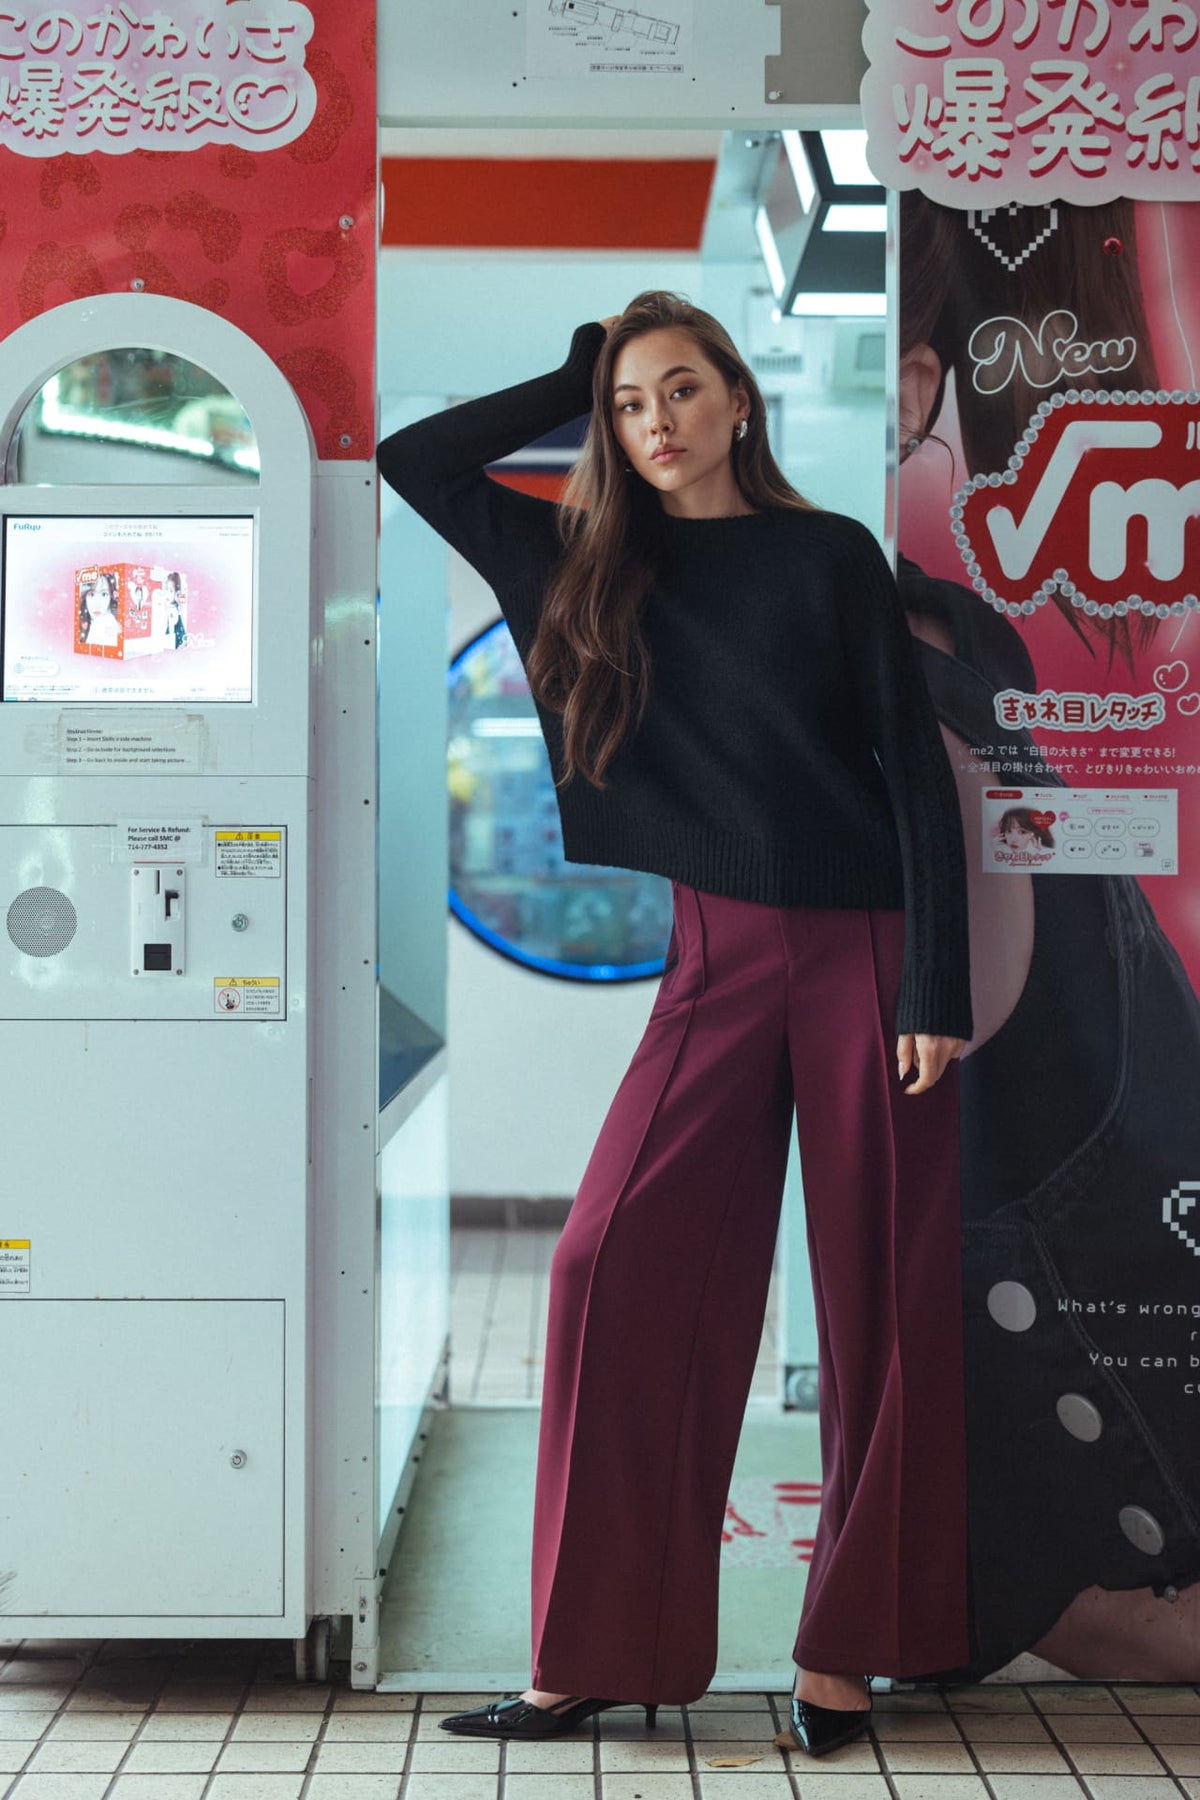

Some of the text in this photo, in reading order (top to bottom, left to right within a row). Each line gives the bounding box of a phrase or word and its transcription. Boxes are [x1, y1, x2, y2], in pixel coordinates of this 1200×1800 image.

[968, 309, 1136, 395] New
[1058, 1298, 1127, 1314] What's
[1089, 1352, 1128, 1367] You
[1140, 1356, 1177, 1367] can
